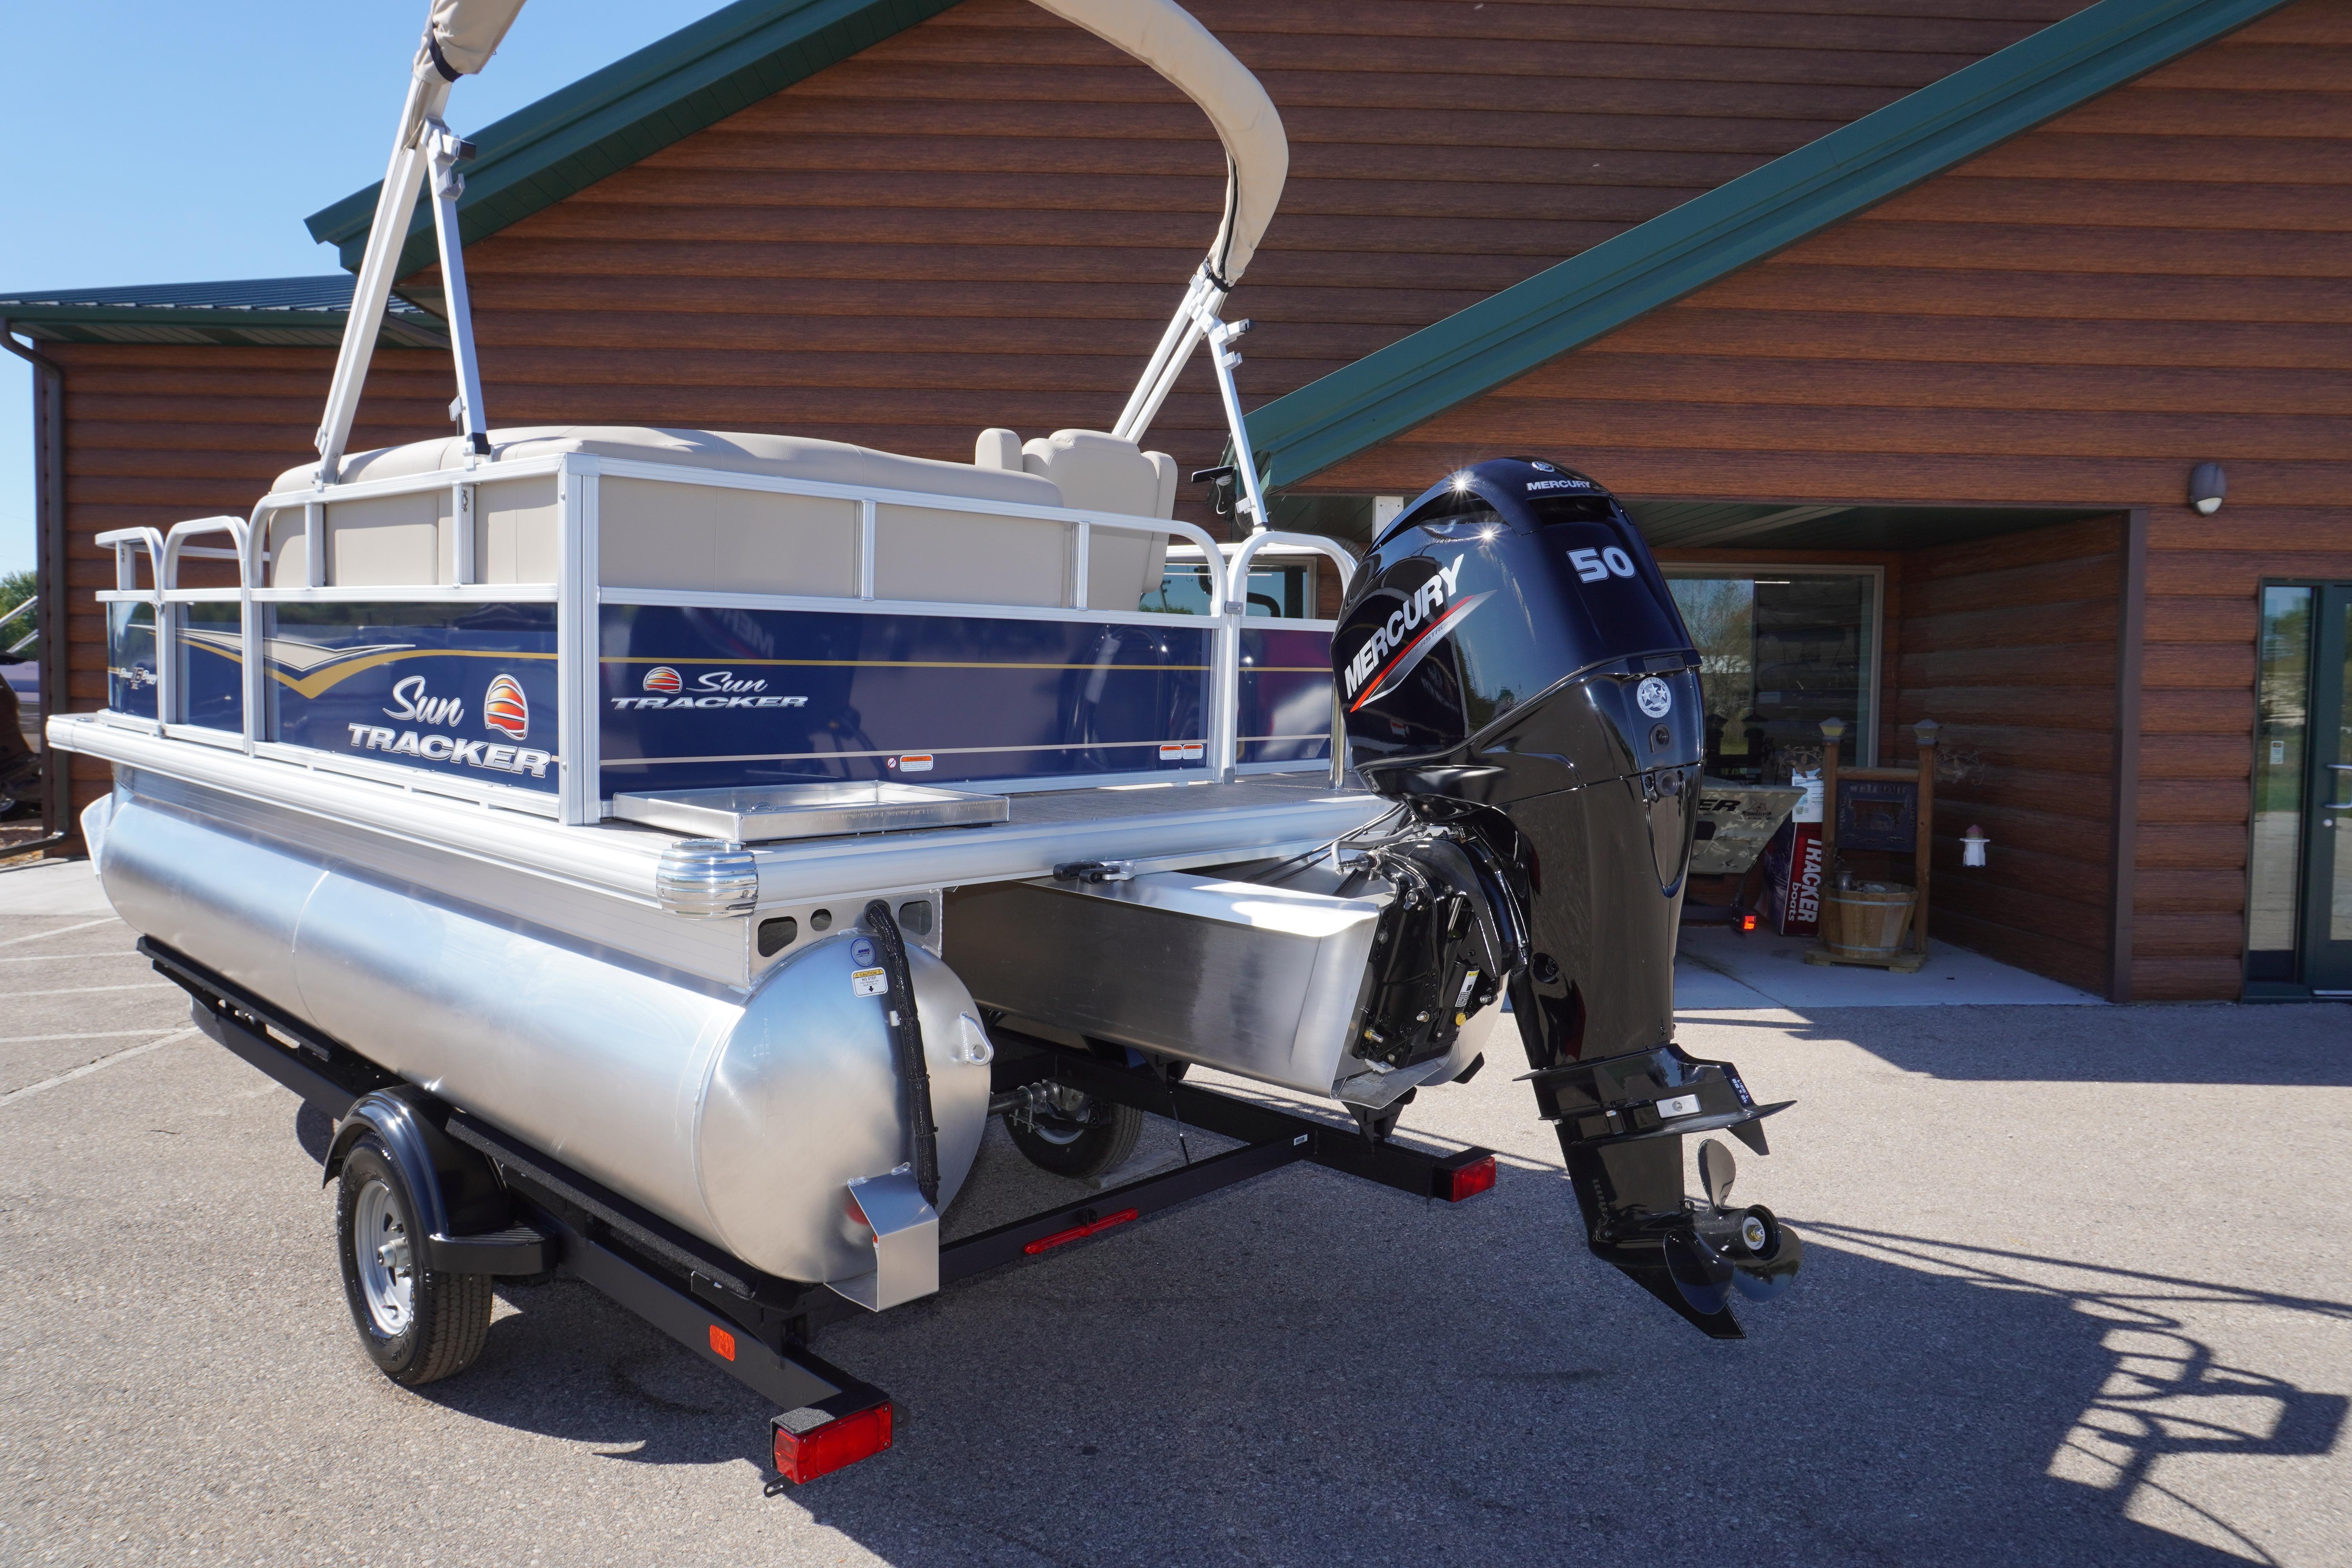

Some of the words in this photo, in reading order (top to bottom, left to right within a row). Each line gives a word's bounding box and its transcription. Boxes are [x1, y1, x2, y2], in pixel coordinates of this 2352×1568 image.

[1526, 480, 1591, 491] MERCURY
[1566, 546, 1636, 583] 50
[1345, 554, 1464, 699] MERCURY
[383, 675, 465, 727] Sun
[686, 671, 768, 693] Sun
[611, 697, 809, 710] TRACKER
[348, 723, 551, 778] TRACKER
[1788, 882, 1802, 921] boats
